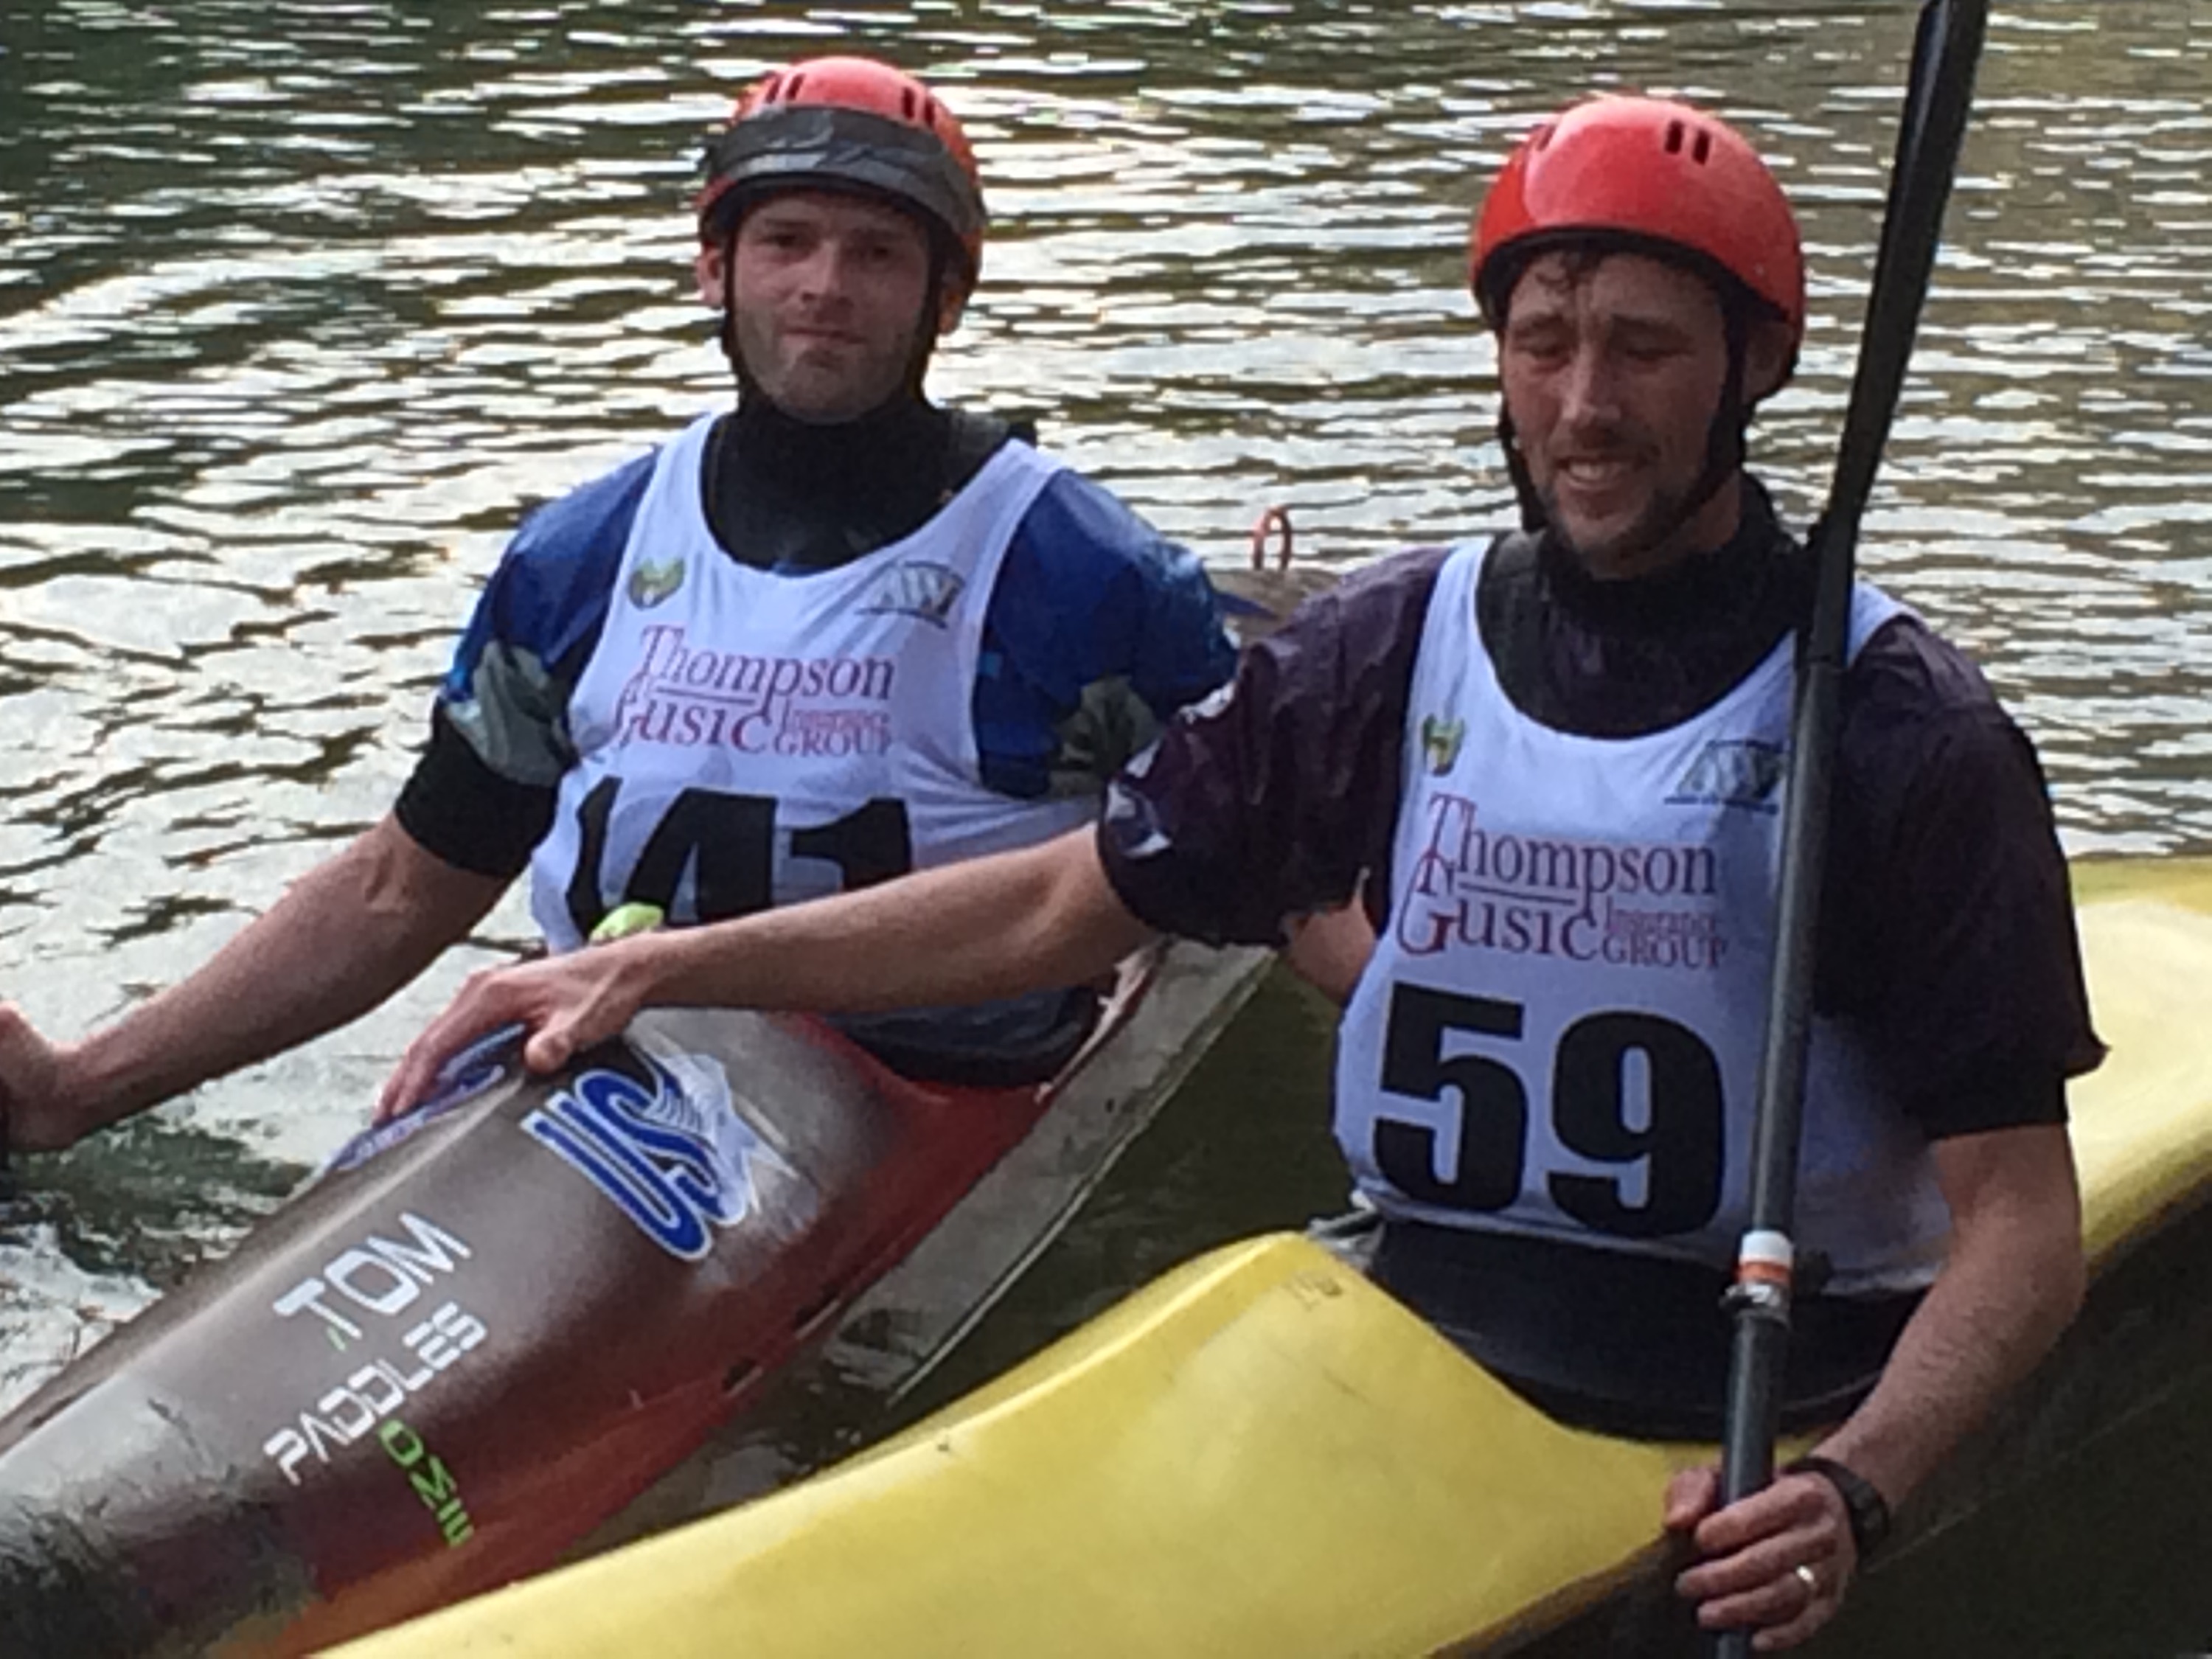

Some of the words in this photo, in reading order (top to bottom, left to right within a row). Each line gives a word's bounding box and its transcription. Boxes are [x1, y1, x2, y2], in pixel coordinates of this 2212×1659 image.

[633, 624, 896, 715] Thompson
[565, 776, 913, 941] 141
[1416, 791, 1718, 918] Thompson
[1601, 933, 1729, 970] GROUP
[1373, 981, 1727, 1237] 59
[274, 1212, 472, 1338] TOM
[264, 1301, 487, 1485] PADDLES
